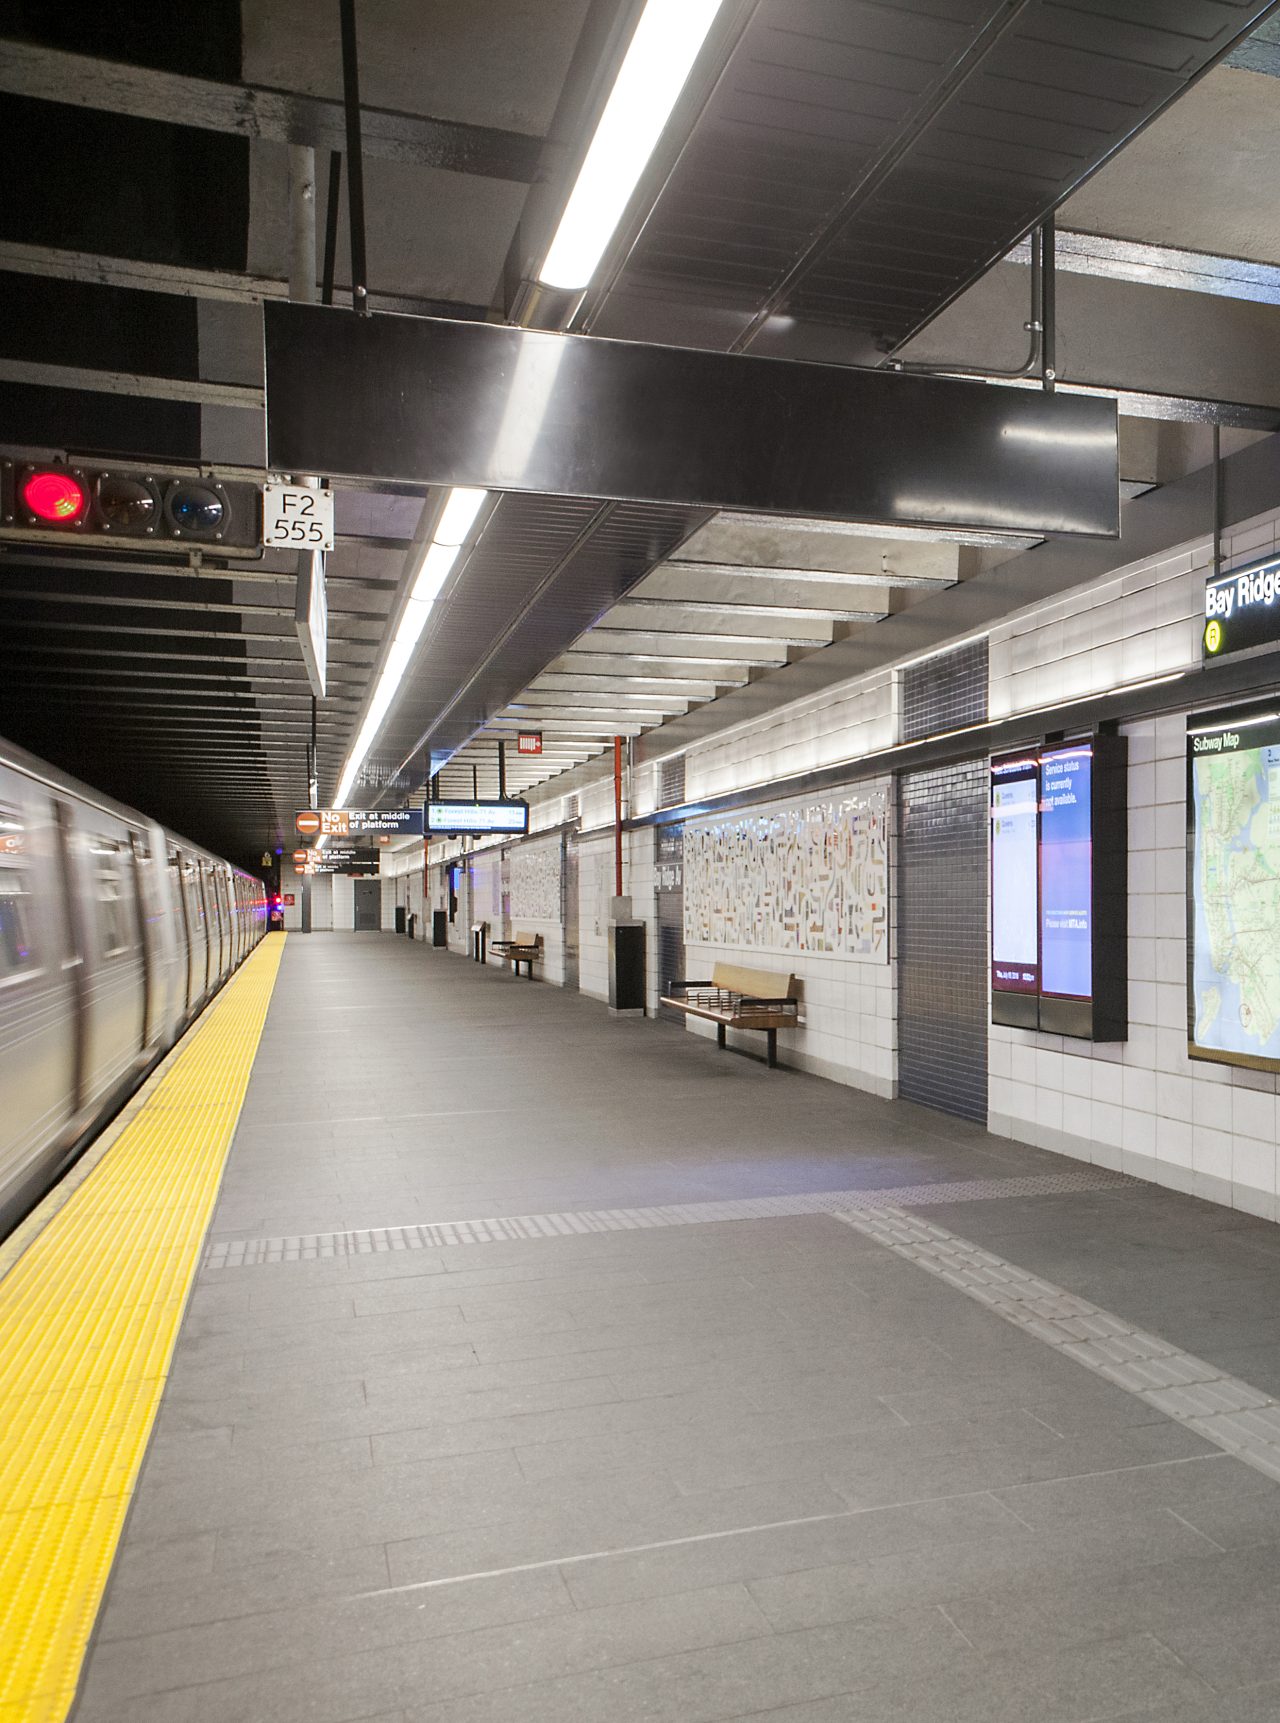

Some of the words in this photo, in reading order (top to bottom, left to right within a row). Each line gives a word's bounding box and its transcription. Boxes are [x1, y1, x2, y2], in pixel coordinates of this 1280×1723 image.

[283, 494, 314, 516] F2
[274, 520, 322, 542] 555
[1206, 588, 1234, 618] Bay
[1194, 736, 1222, 751] Subway
[1223, 732, 1239, 748] Map
[1046, 763, 1063, 776] Service
[1064, 761, 1079, 772] status
[1046, 780, 1050, 790] is
[1051, 778, 1072, 790] currently
[1055, 793, 1076, 806] available.
[322, 812, 340, 822] No
[322, 823, 346, 832] Exit
[362, 821, 399, 829] platform
